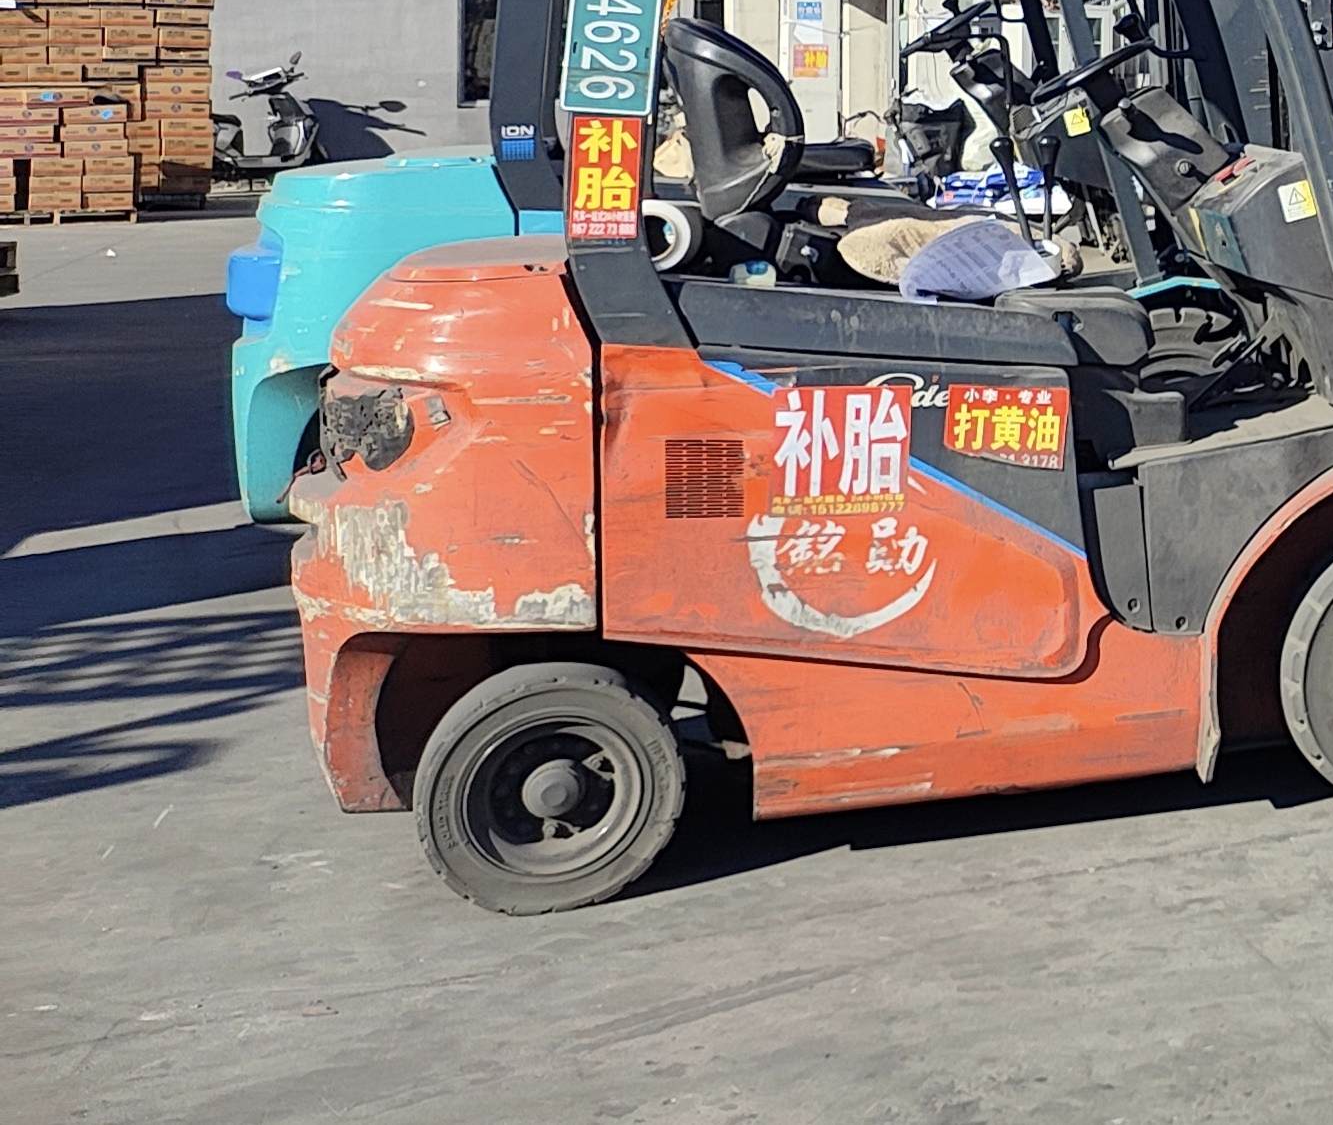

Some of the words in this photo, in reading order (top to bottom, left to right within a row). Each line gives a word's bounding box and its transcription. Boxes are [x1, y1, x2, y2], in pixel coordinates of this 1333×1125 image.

[501, 124, 535, 139] ION
[574, 119, 638, 210] 补胎
[774, 388, 907, 497] 补胎
[953, 403, 1061, 452] 打黄油
